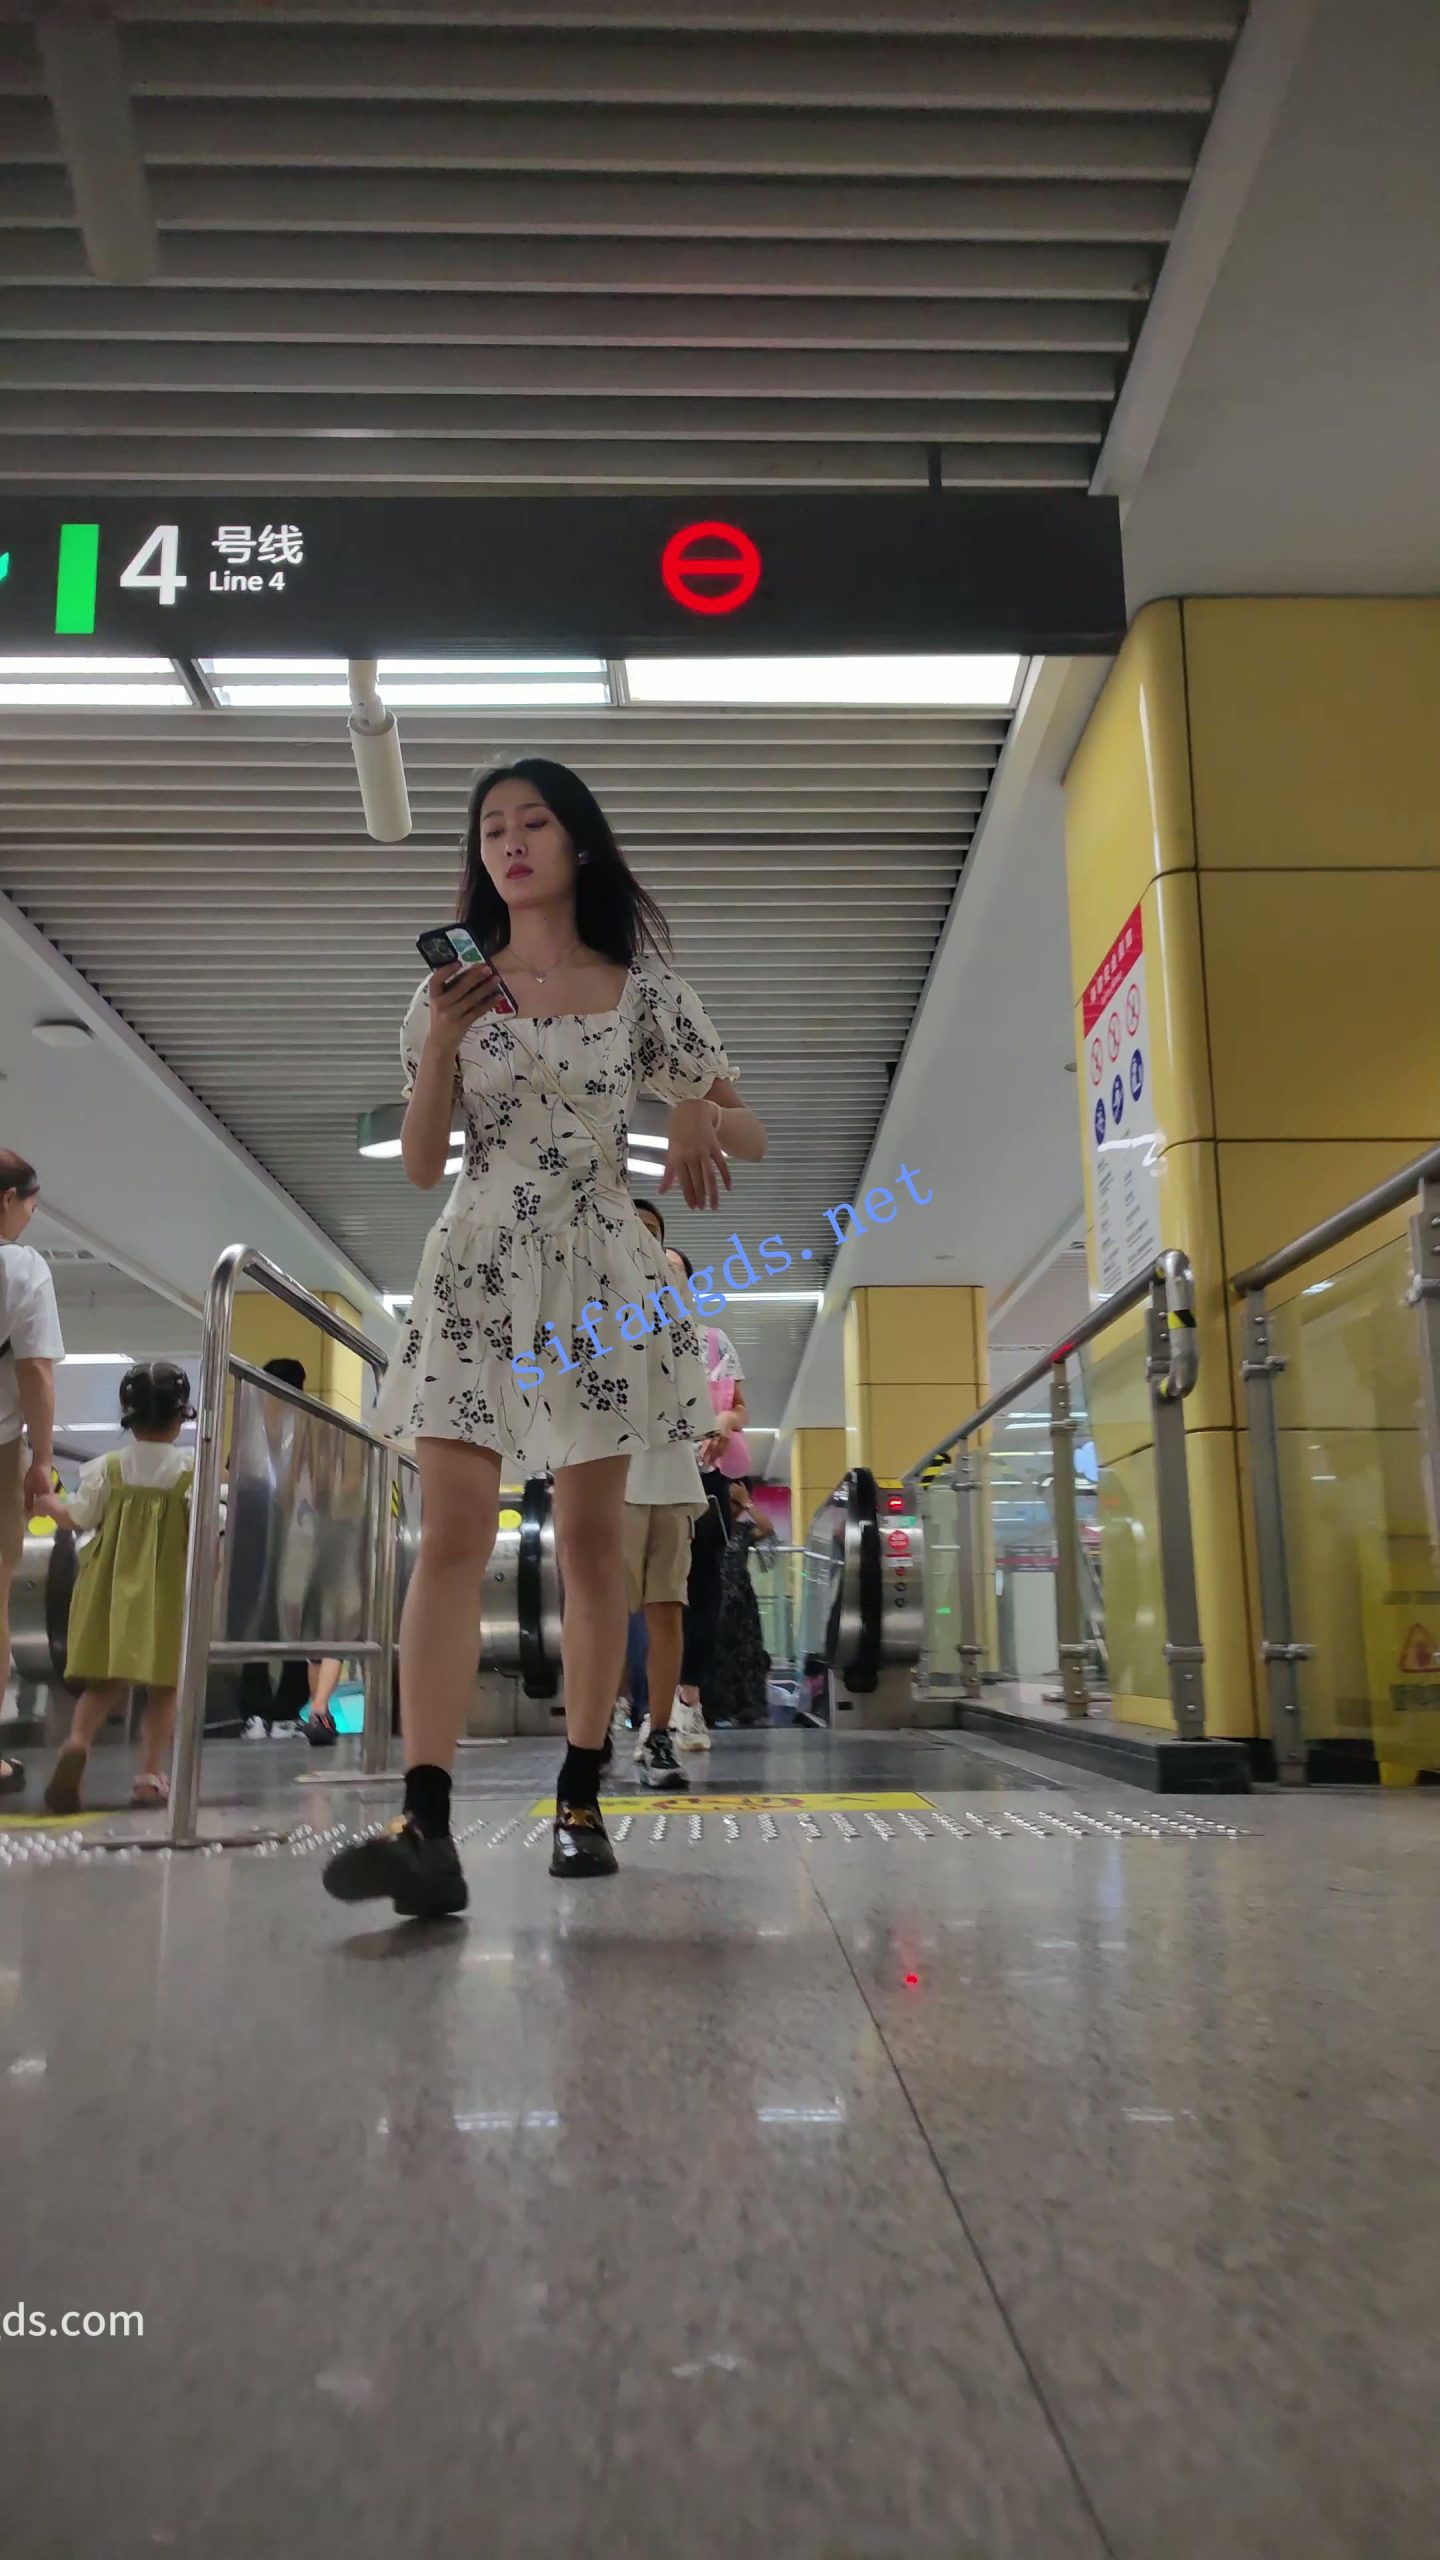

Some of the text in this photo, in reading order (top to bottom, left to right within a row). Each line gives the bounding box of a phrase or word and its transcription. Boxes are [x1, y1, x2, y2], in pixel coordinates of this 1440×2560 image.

[119, 524, 304, 606] 4 号线
[209, 570, 286, 592] Line 4
